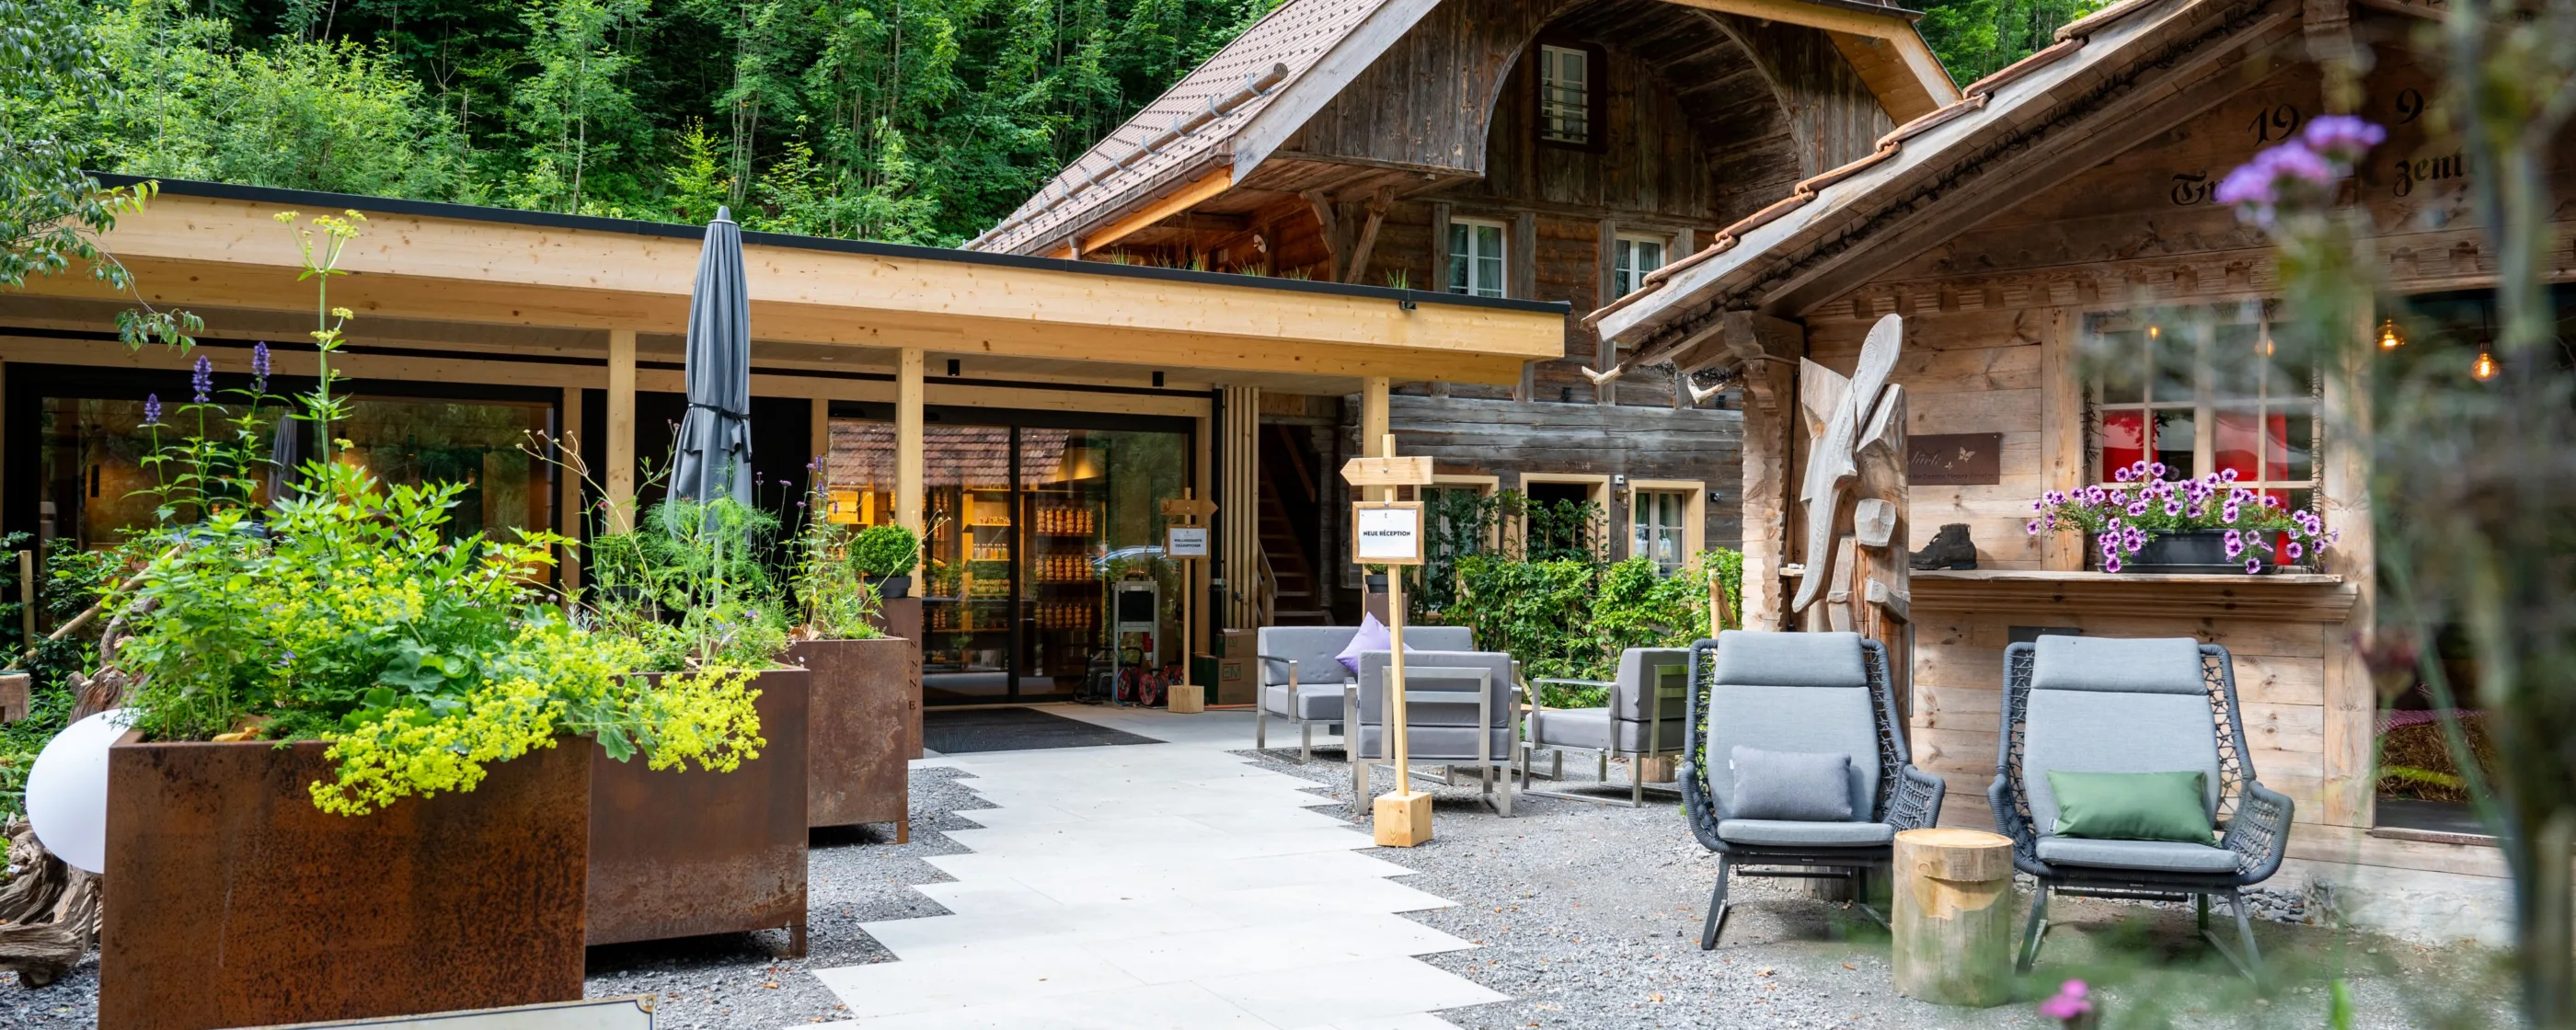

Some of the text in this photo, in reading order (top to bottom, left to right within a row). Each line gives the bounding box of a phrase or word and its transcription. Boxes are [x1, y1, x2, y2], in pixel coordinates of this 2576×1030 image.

[2248, 88, 2426, 147] 19 9
[1379, 529, 1411, 537] RÉCEPTION
[1222, 665, 1242, 679] EM
